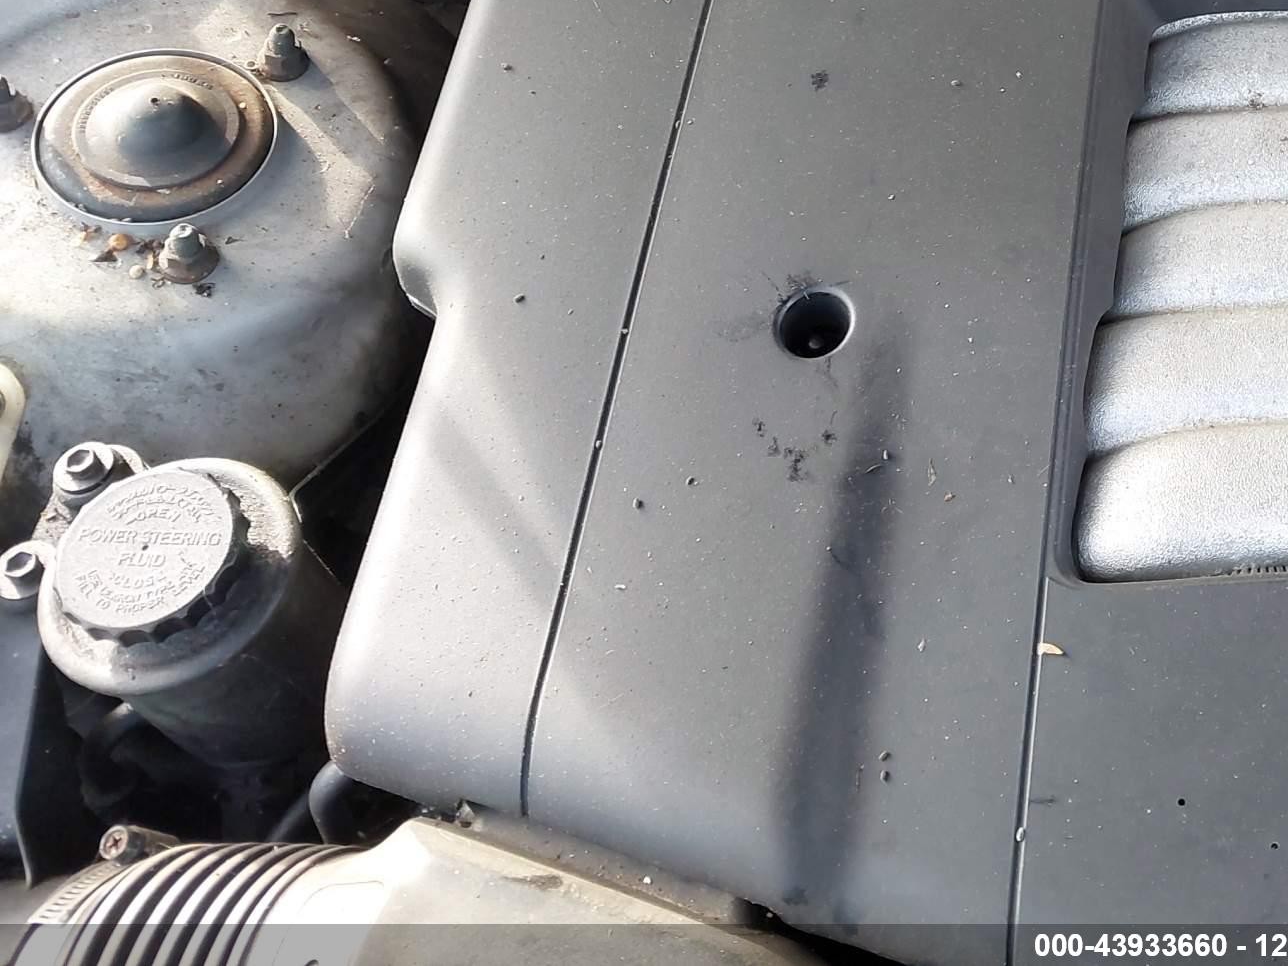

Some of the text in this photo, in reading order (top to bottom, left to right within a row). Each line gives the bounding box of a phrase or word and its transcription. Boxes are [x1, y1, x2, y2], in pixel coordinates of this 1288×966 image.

[78, 529, 222, 546] POWER STEERING
[118, 553, 166, 568] FLUID
